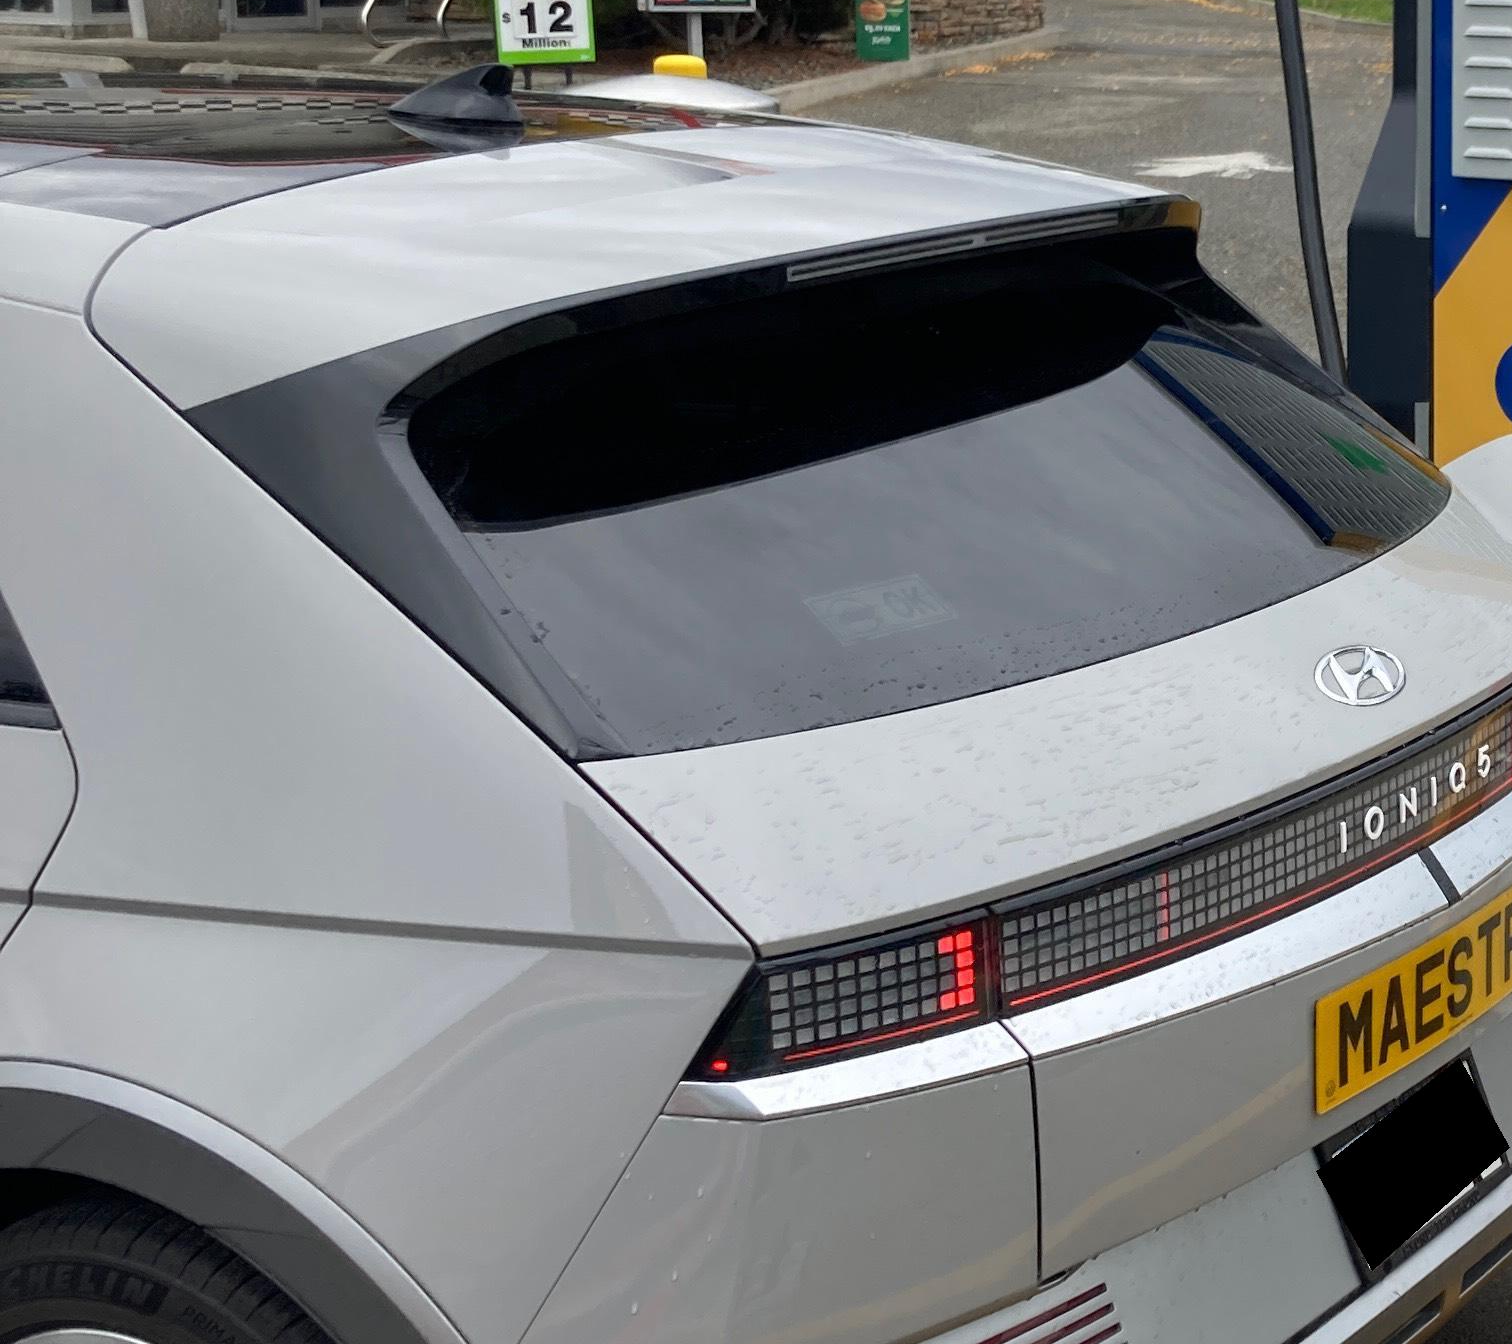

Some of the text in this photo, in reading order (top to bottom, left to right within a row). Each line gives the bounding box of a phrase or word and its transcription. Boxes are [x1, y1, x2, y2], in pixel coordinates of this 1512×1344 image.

[501, 0, 573, 34] $ 12
[1338, 743, 1491, 854] IONIQ 5
